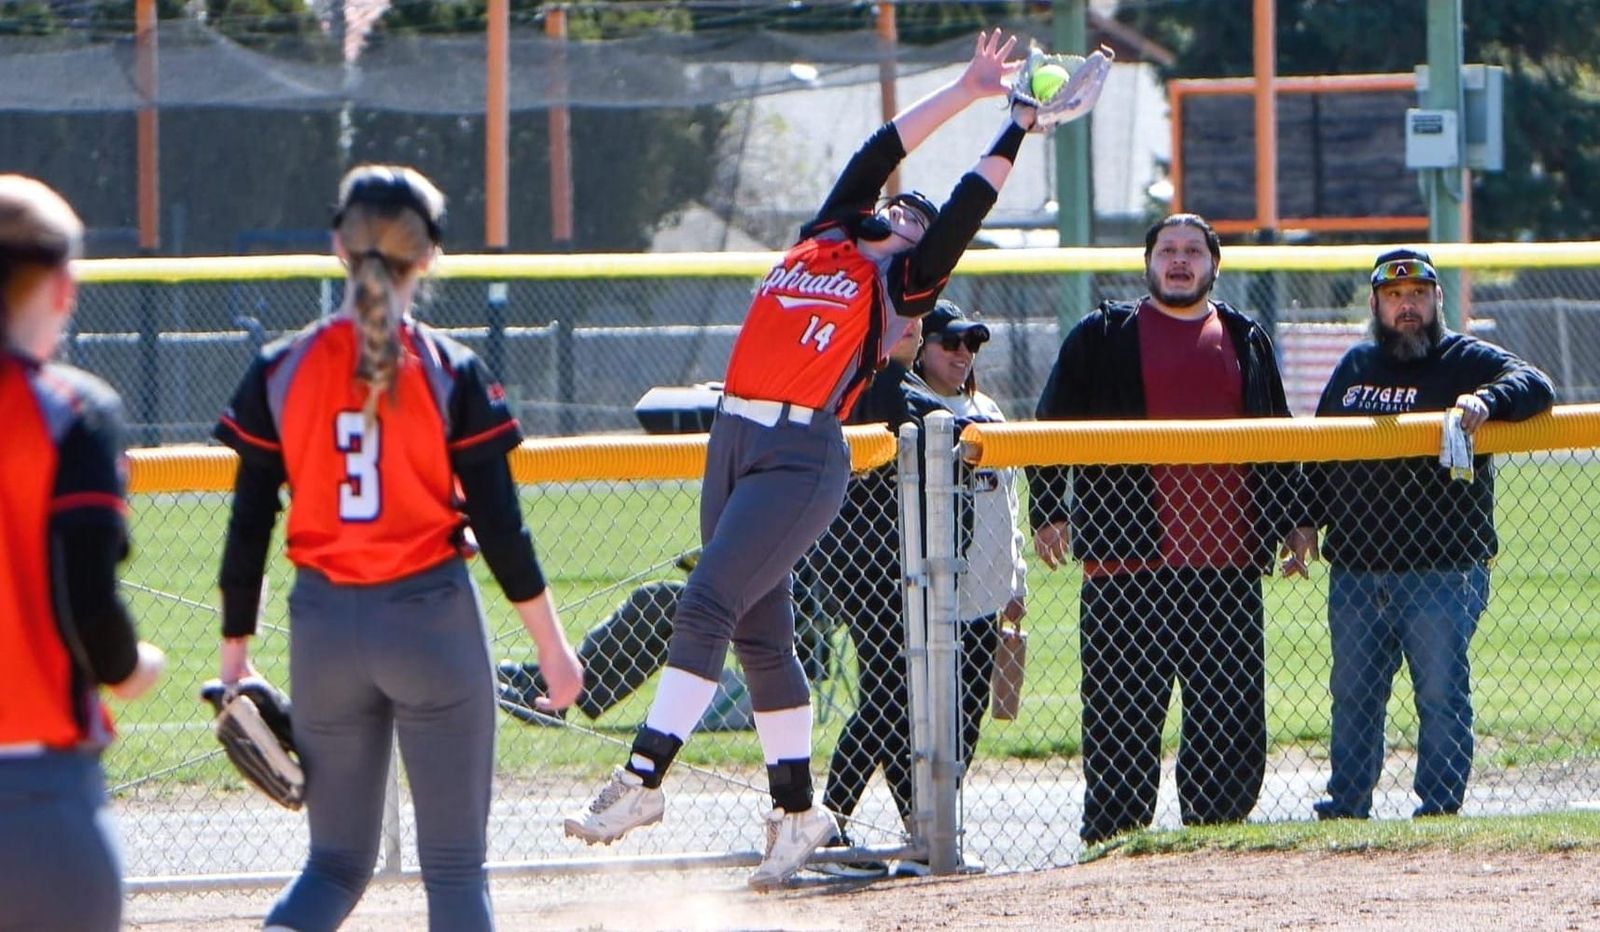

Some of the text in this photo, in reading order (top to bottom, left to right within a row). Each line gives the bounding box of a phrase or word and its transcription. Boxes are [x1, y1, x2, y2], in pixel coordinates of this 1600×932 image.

[760, 260, 860, 299] phrata
[800, 314, 836, 352] 14
[1358, 401, 1411, 412] SOFTBALL
[1361, 384, 1418, 404] TIGER
[334, 409, 382, 522] 3
